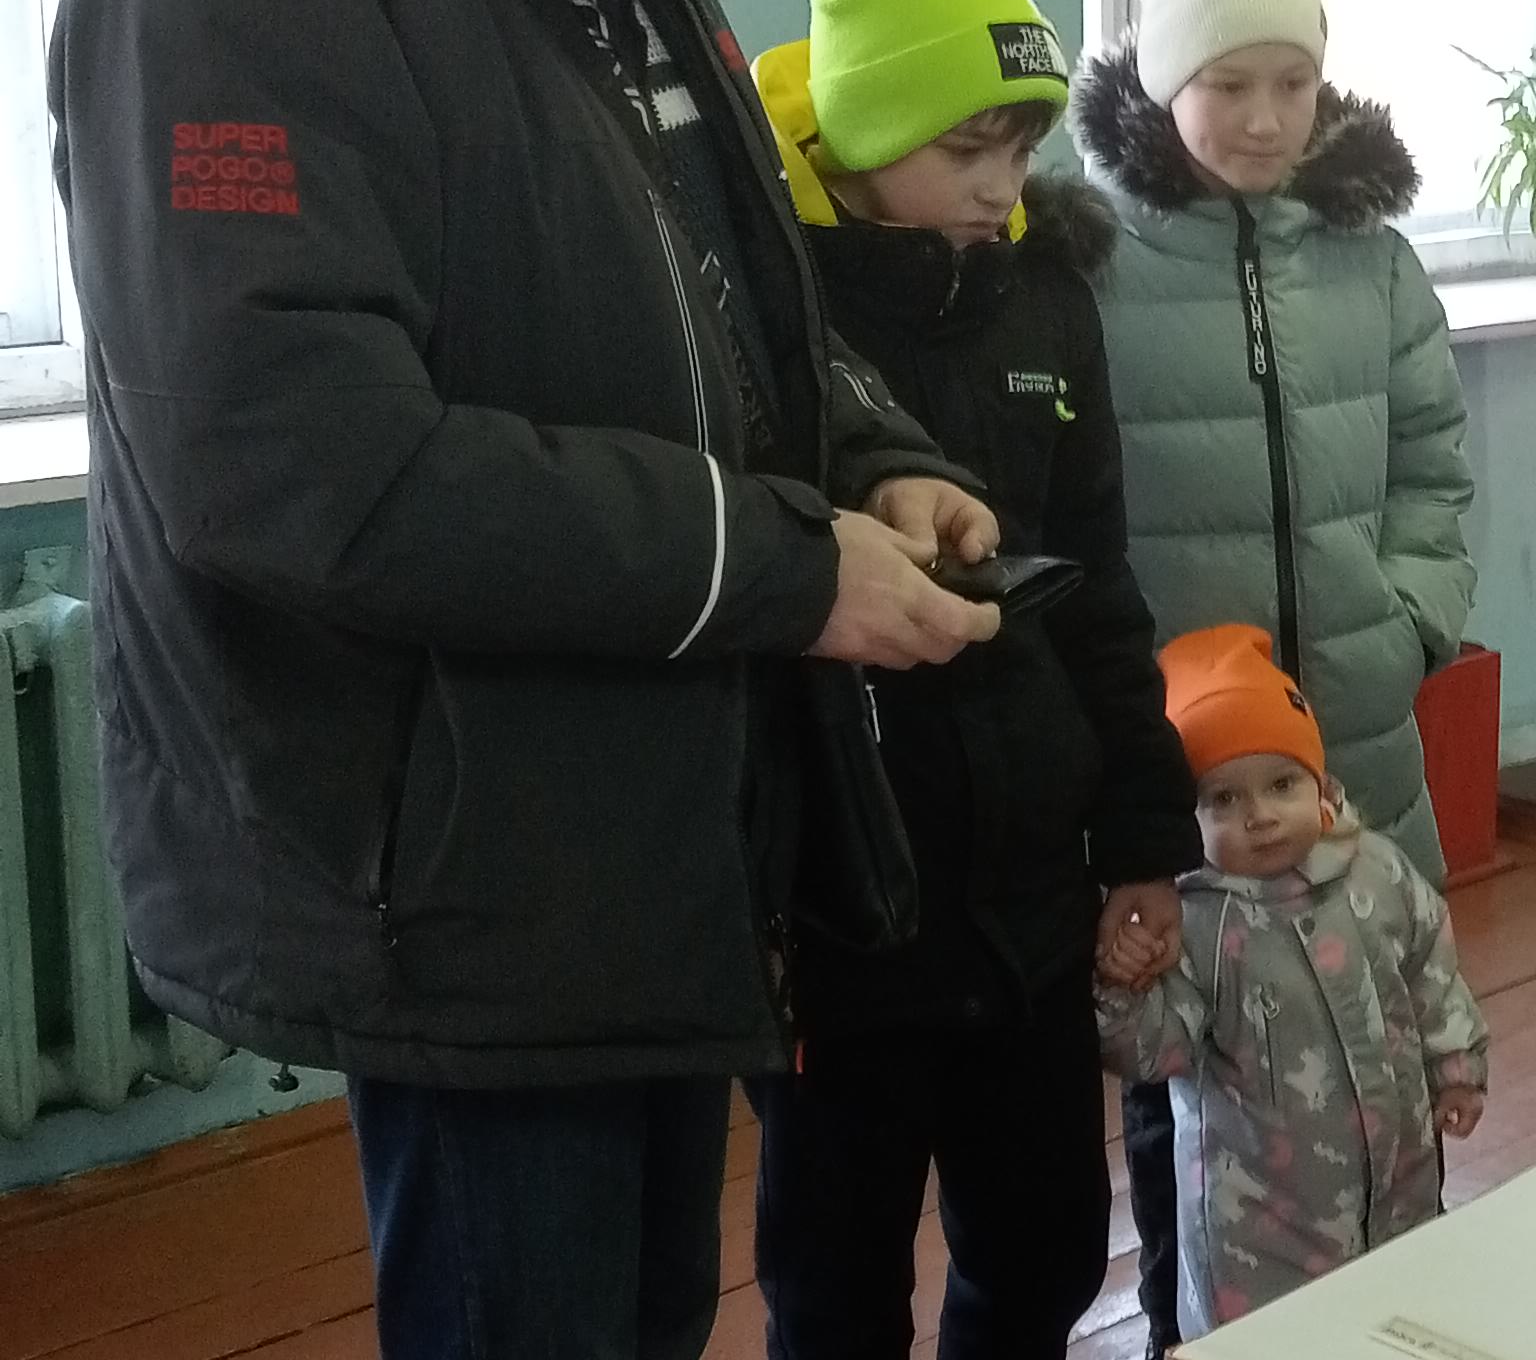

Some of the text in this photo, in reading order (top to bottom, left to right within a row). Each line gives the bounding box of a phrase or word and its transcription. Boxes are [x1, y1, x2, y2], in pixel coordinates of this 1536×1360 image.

[1019, 27, 1045, 44] THE
[1002, 42, 1050, 59] NORTH
[1021, 59, 1053, 73] FACE
[173, 123, 288, 152] SUPER
[170, 186, 300, 215] DESIGN
[1245, 259, 1267, 375] FUTURINO
